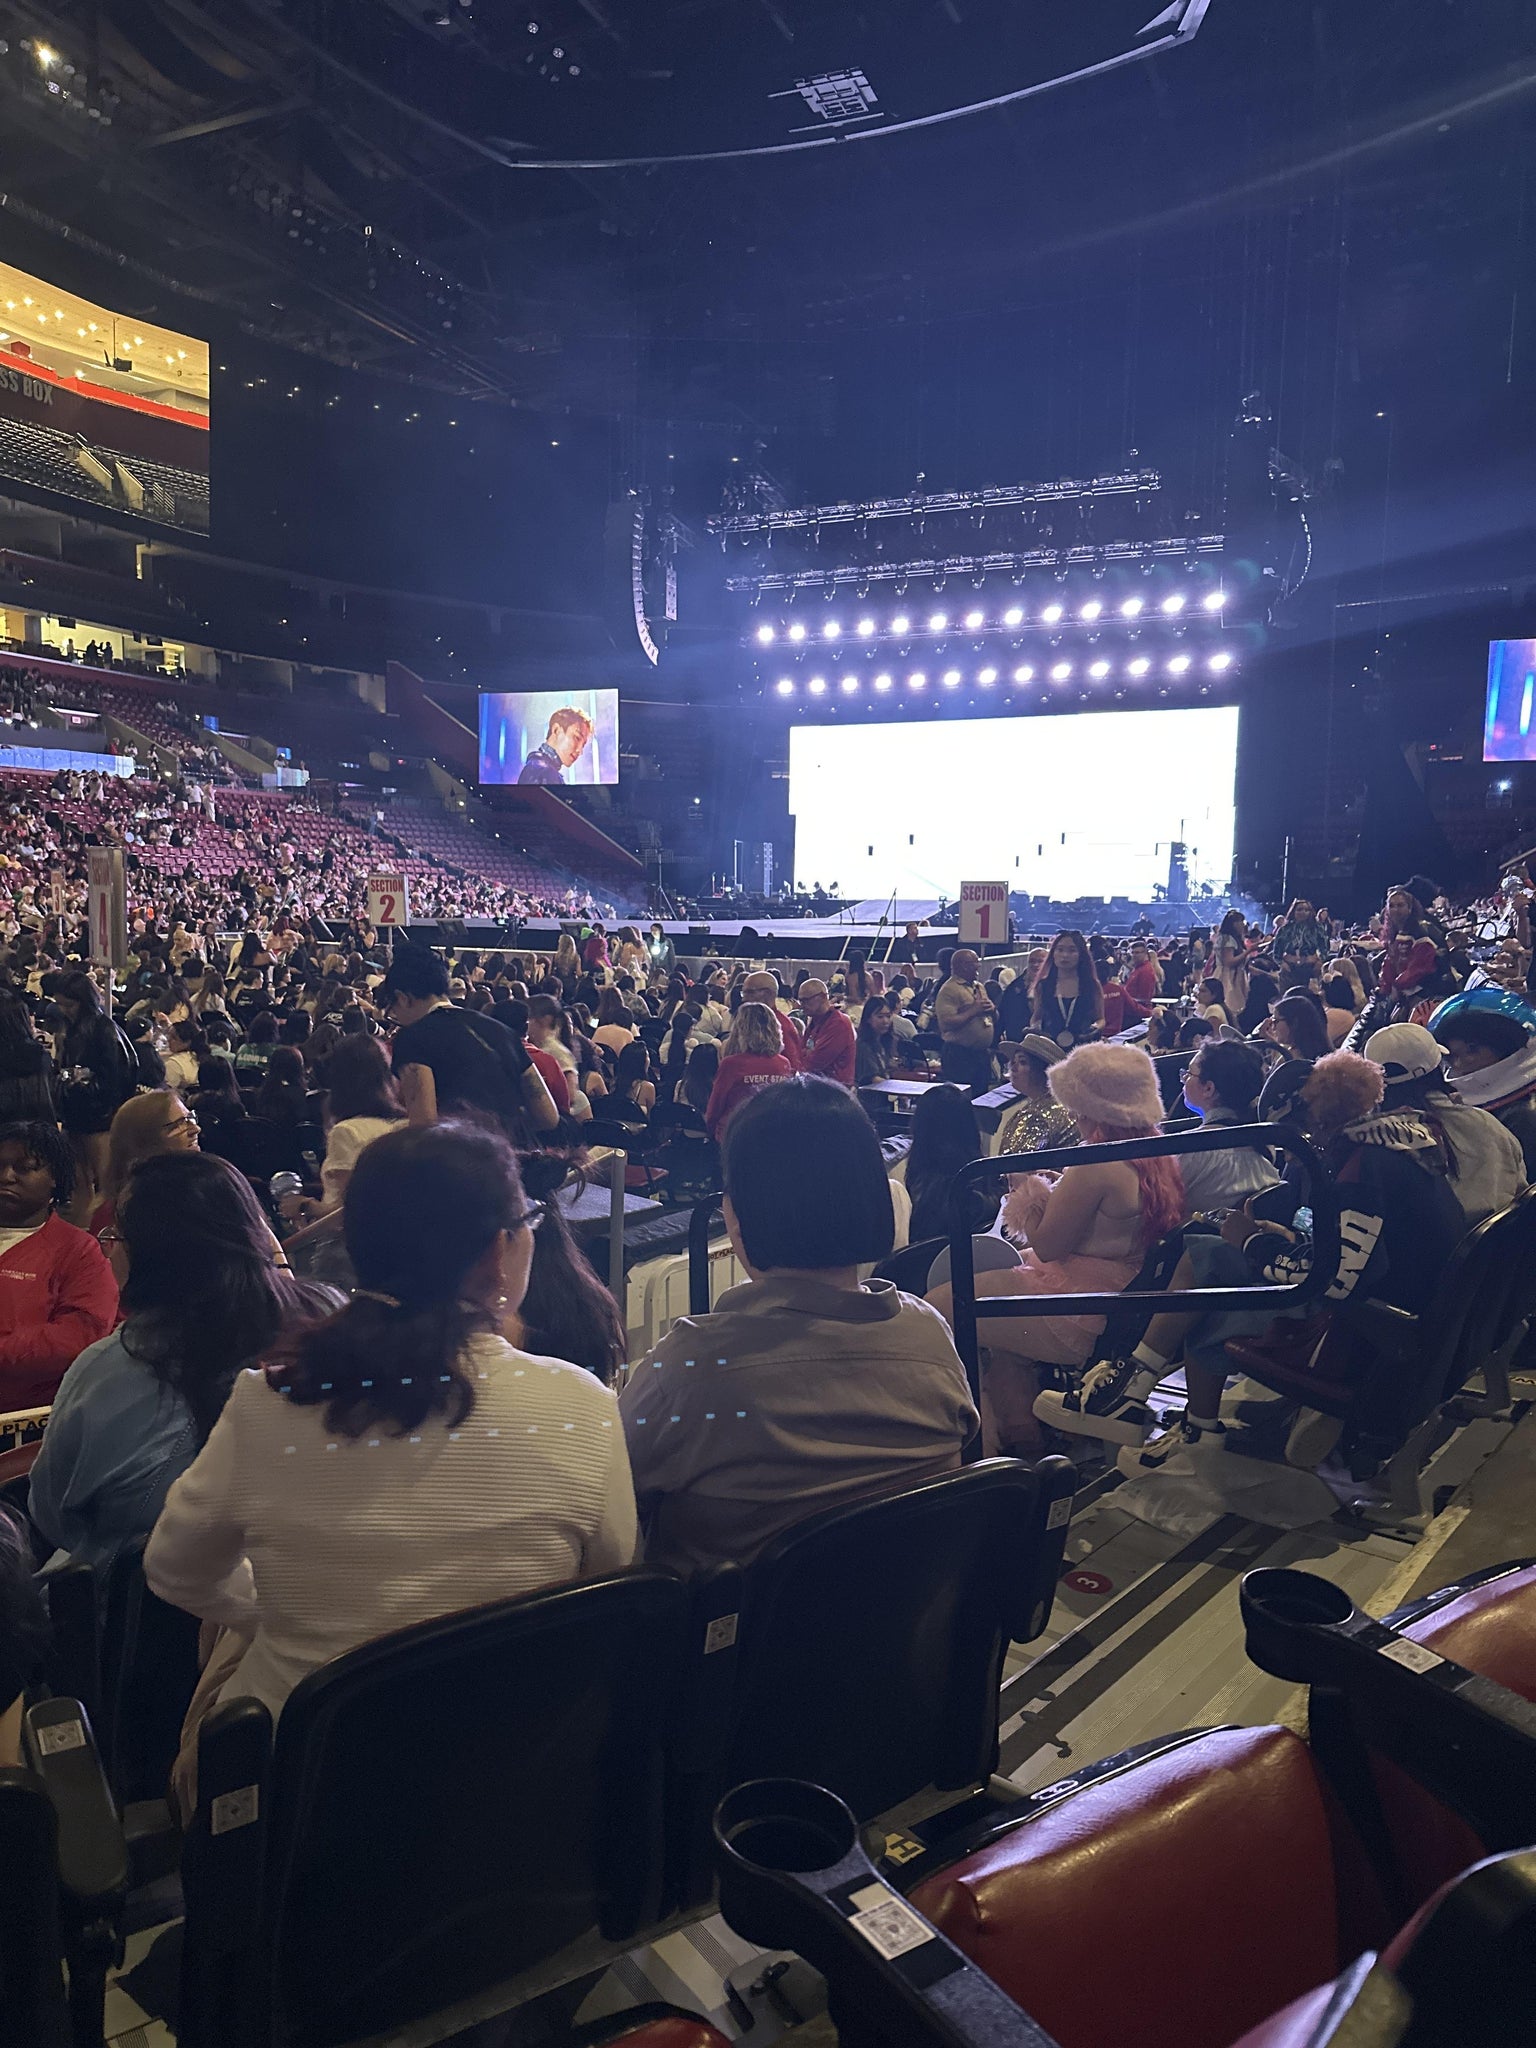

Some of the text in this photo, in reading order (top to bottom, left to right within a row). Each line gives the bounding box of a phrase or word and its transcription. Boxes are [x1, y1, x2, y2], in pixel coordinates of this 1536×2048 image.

[22, 376, 54, 406] BOX
[370, 879, 404, 892] SECTION
[962, 885, 1004, 901] SECTION
[379, 894, 395, 923] 2
[99, 892, 109, 957] 4
[975, 904, 990, 938] 1
[743, 1074, 769, 1083] EVENT
[1076, 1577, 1099, 1589] 3
[889, 1839, 920, 1858] H
